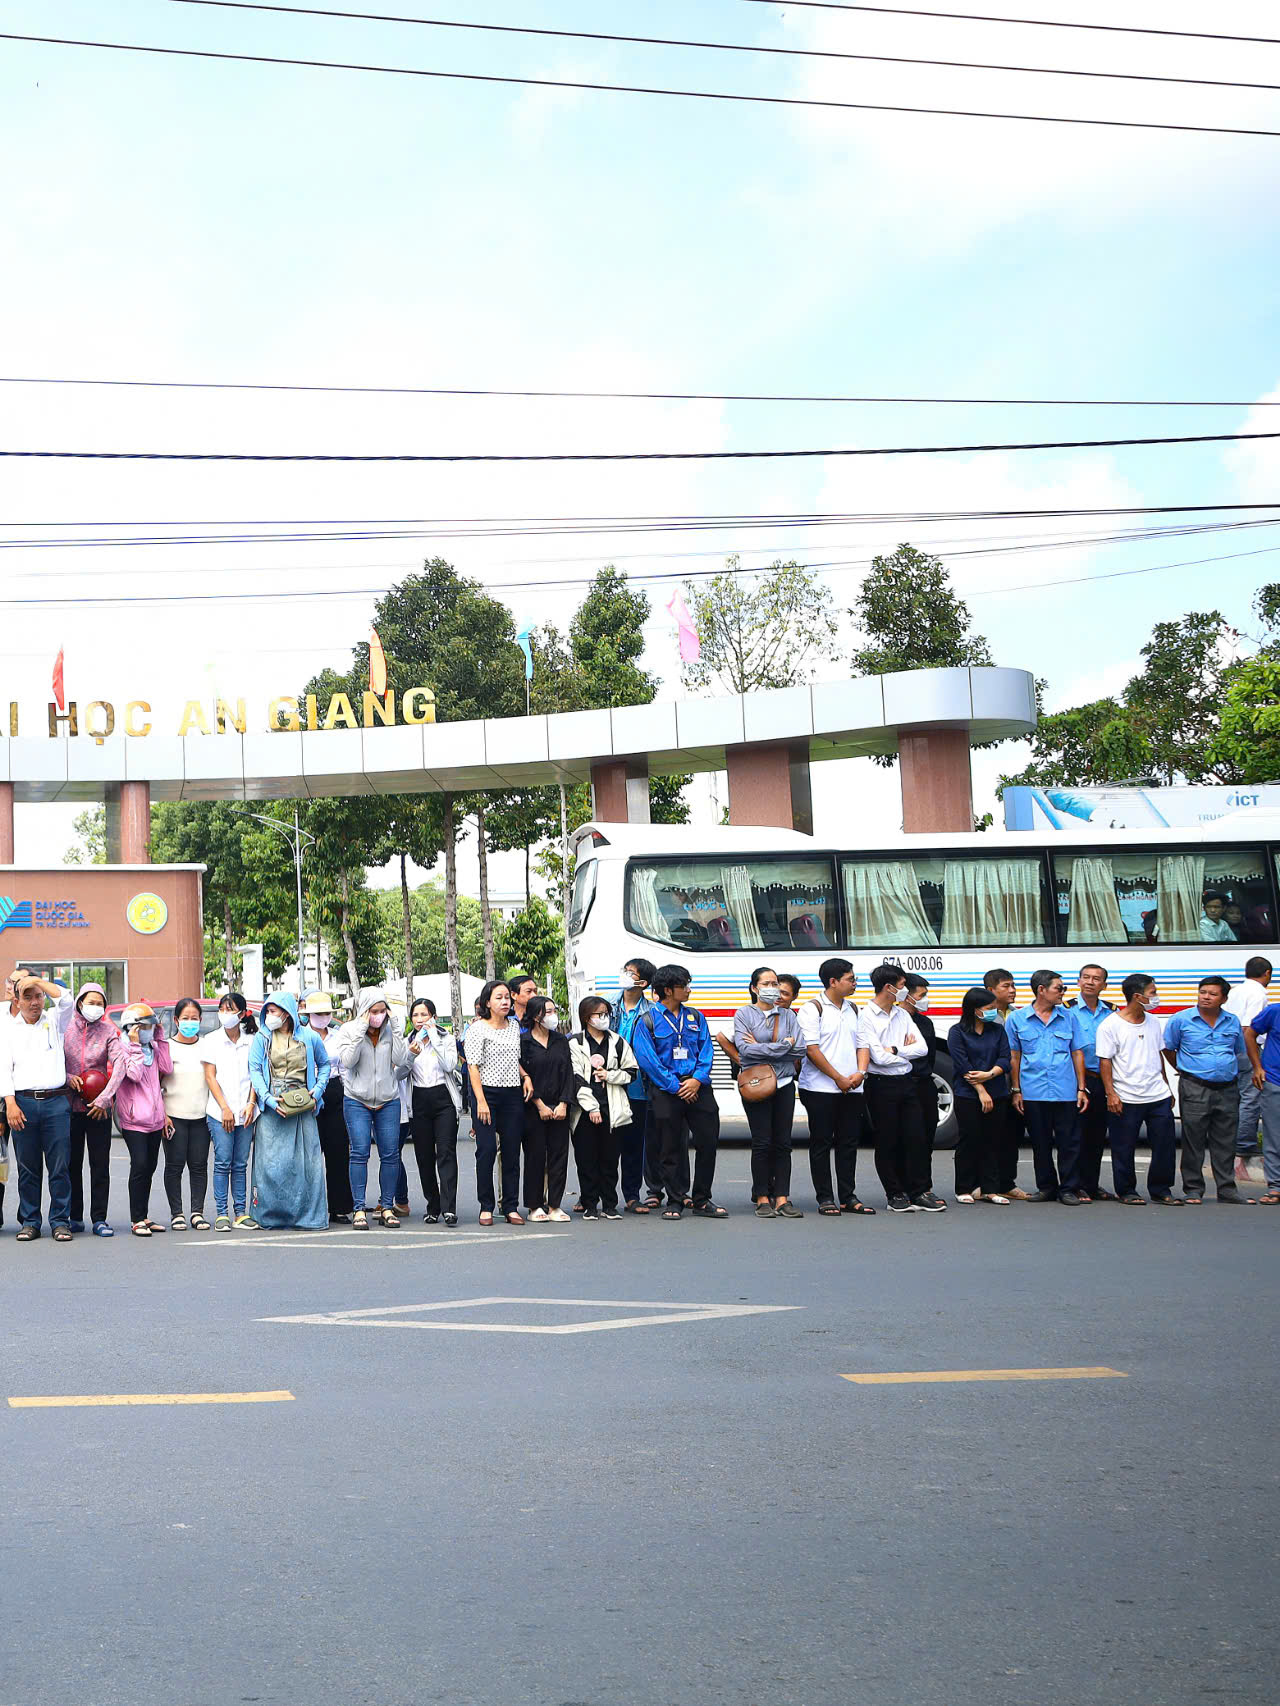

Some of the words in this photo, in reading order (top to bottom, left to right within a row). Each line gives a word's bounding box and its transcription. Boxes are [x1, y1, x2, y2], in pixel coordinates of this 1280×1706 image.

[47, 700, 153, 746] HỌC
[177, 696, 247, 737] AN
[268, 686, 437, 733] GIANG
[36, 901, 53, 910] ĐẠI
[54, 901, 76, 910] HỌC
[35, 910, 65, 920] QUỐC
[67, 911, 85, 920] GIA
[882, 955, 943, 971] 67A-003.06
